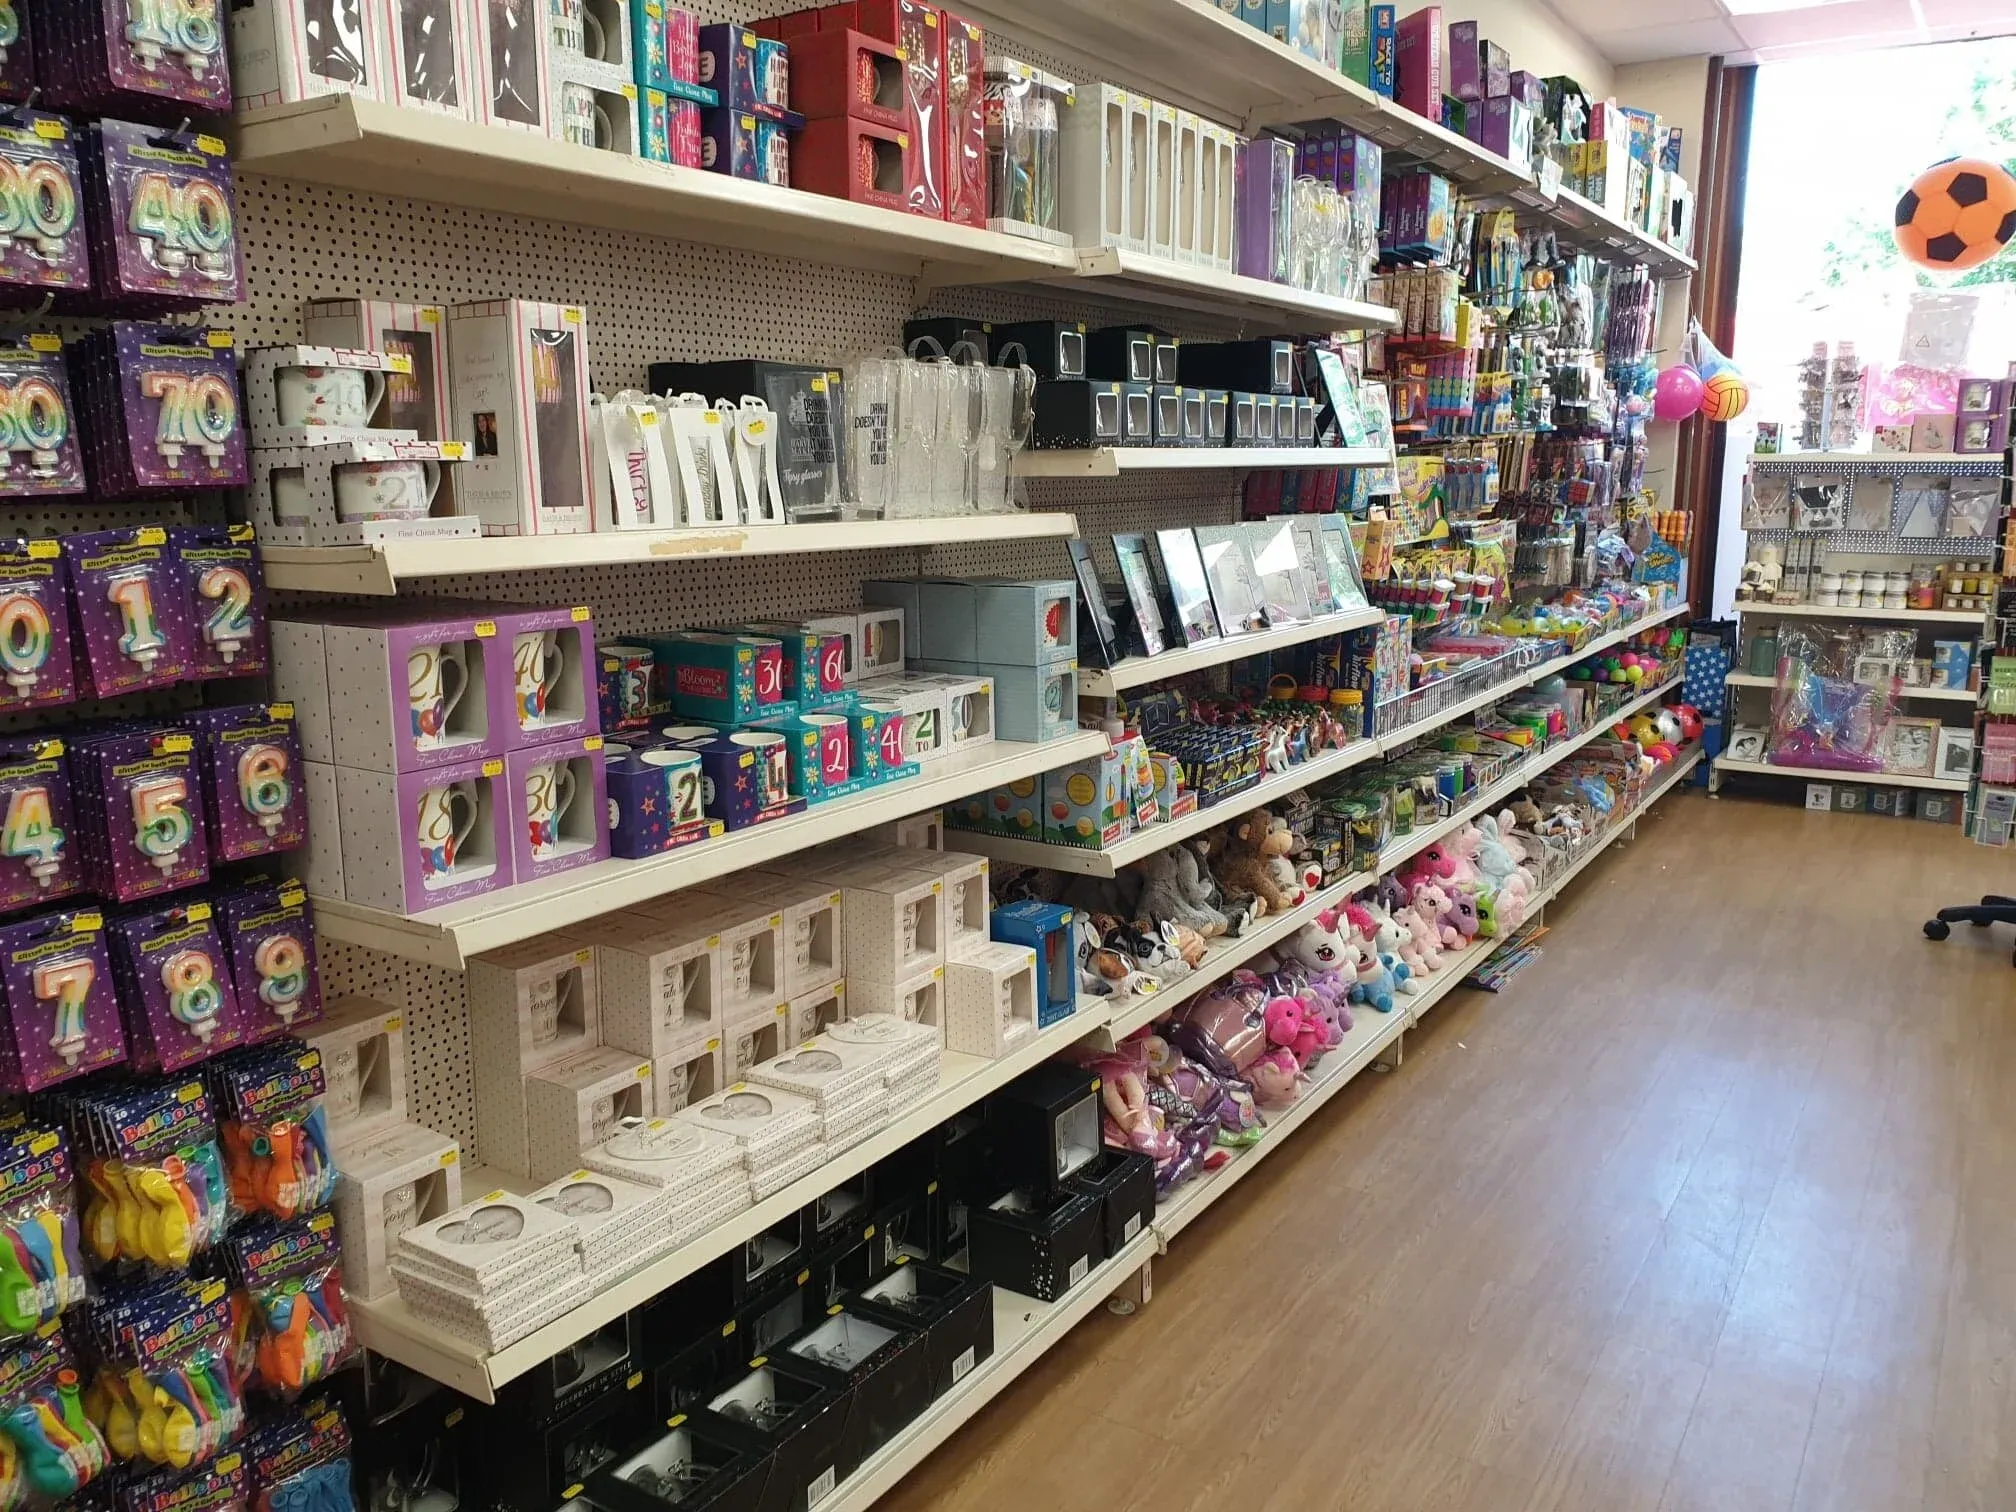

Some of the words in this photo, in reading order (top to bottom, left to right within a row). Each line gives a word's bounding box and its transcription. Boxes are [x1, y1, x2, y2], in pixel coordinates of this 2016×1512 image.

[129, 171, 232, 252] 40
[141, 371, 235, 443] 70
[398, 530, 413, 538] Fine
[415, 528, 436, 538] China
[438, 528, 453, 537] Mug
[29, 565, 48, 573] sides
[86, 558, 109, 569] Glitter
[120, 554, 137, 562] both
[138, 550, 155, 558] sides
[107, 575, 166, 653] 1
[199, 566, 255, 642] 2
[408, 651, 444, 703] 21
[760, 709, 771, 717] Fine
[784, 705, 795, 713] Mug
[542, 728, 565, 742] China
[567, 724, 587, 737] Mug
[167, 757, 184, 765] sides
[438, 748, 464, 764] China
[467, 745, 489, 759] Mug
[36, 763, 53, 771] sides
[886, 772, 895, 780] Fine
[895, 769, 906, 778] China
[907, 766, 916, 774] Mug
[237, 744, 292, 815] 6
[827, 789, 837, 797] Fine
[837, 785, 850, 794] China
[850, 782, 860, 791] Mug
[677, 772, 698, 822] 2
[2, 787, 65, 859] 4
[130, 777, 194, 858] 5
[416, 788, 453, 842] 18
[554, 859, 576, 873] China
[577, 854, 597, 867] Mug
[446, 886, 473, 901] China
[475, 879, 496, 894] Mug
[189, 926, 205, 934] sides
[18, 947, 43, 960] Glitter
[54, 941, 72, 950] both
[72, 936, 90, 945] sides
[255, 935, 308, 1006] 9
[161, 951, 223, 1024] 8
[33, 958, 95, 1045] 7
[239, 1075, 251, 1085] 10
[242, 1066, 321, 1108] Balloons
[114, 1110, 128, 1121] 10
[119, 1096, 206, 1145] Balloons
[156, 1121, 188, 1140] Birthday
[0, 1151, 65, 1190] lloons
[7, 1178, 44, 1198] Birthday
[241, 1237, 254, 1247] 10
[245, 1228, 332, 1270] Balloons
[118, 1309, 132, 1319] 10
[137, 1321, 152, 1332] 10
[143, 1302, 227, 1355] Balloons
[610, 1359, 633, 1378] STYLE
[254, 1445, 266, 1457] 10
[258, 1422, 344, 1476] Balloons
[133, 1485, 147, 1495] 10
[151, 1475, 164, 1486] 10
[154, 1467, 244, 1511] Balloons
